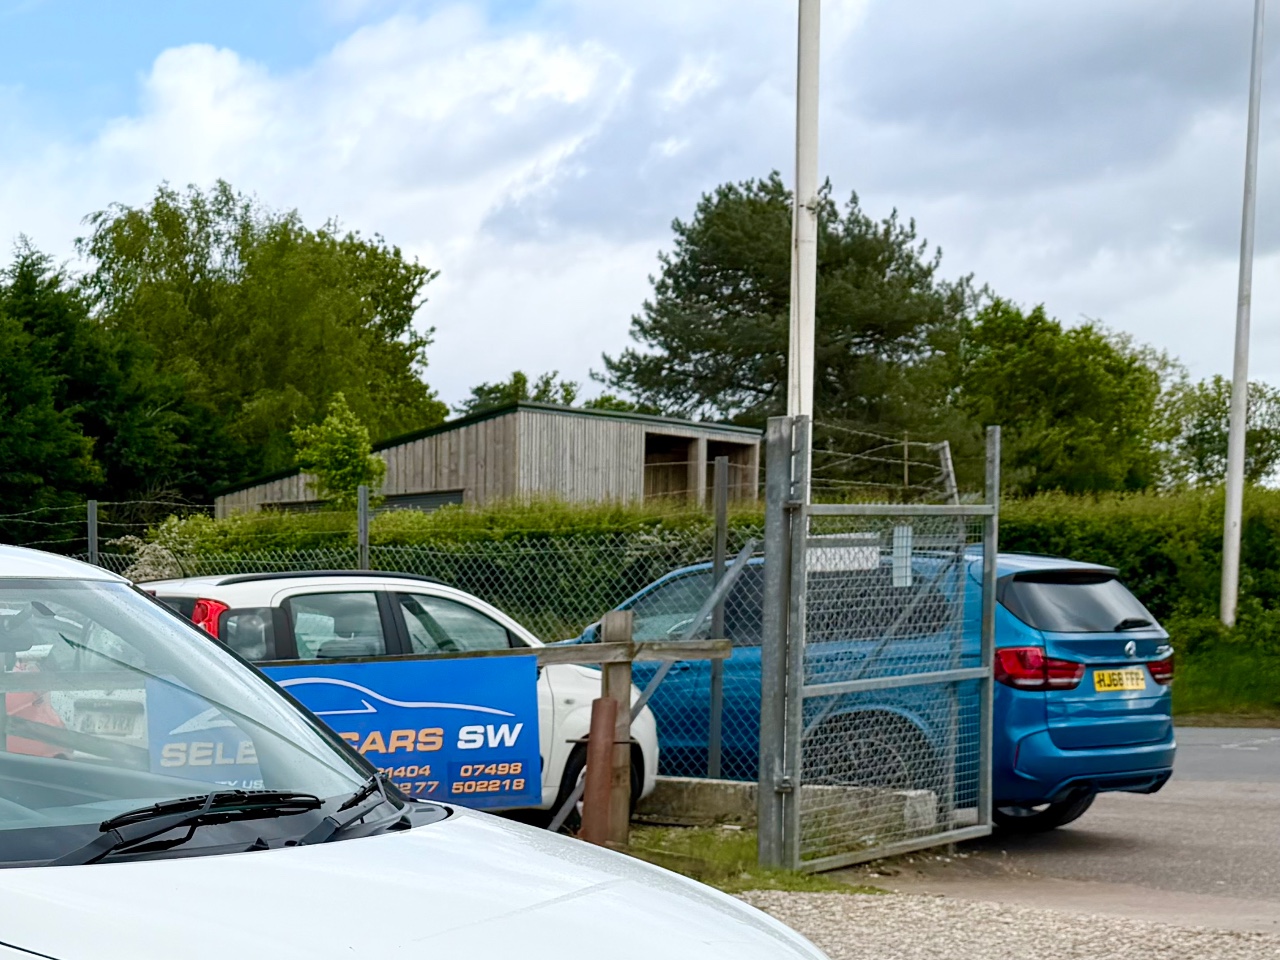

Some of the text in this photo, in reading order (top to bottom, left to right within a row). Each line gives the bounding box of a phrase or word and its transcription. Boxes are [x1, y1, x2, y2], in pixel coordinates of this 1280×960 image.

[160, 741, 258, 767] SELE
[457, 723, 523, 749] SW
[460, 762, 522, 777] 07498
[415, 781, 440, 794] 77
[451, 778, 525, 793] 502218
